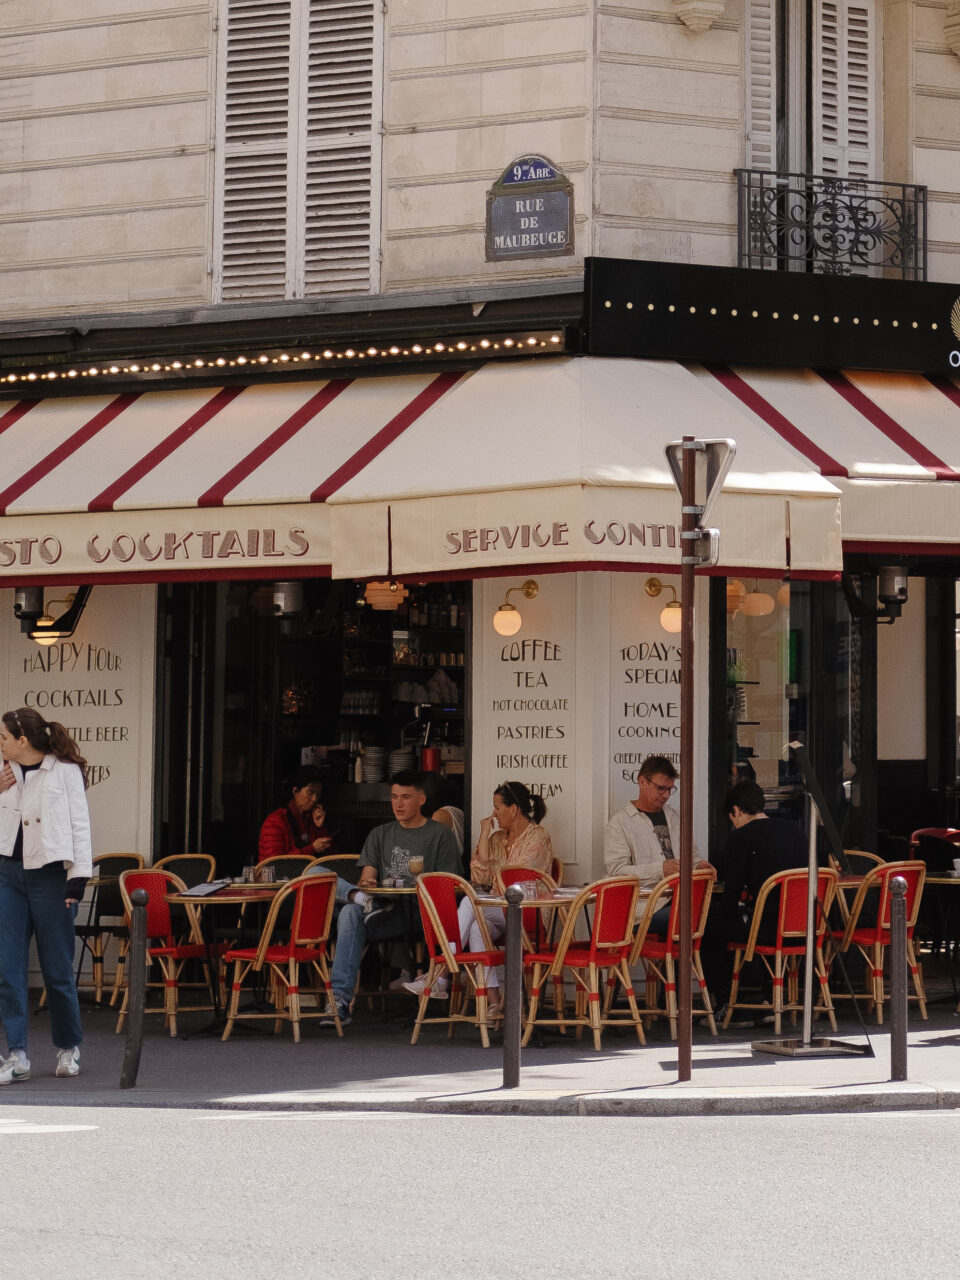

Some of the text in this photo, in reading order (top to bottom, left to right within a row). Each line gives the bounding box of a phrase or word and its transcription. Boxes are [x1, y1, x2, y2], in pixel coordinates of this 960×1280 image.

[515, 198, 545, 213] RUE
[520, 216, 539, 229] DE
[494, 231, 566, 249] MAUBEUGE
[444, 519, 682, 554] SERVICE CONTI
[86, 526, 310, 564] COCKTAILS
[24, 642, 122, 672] HAPPY HOUR
[501, 639, 562, 662] COFFEE
[513, 671, 548, 688] TEA
[24, 688, 123, 707] COCKTAILS
[493, 699, 569, 711] HOT CHOCOLATE
[624, 702, 678, 718] HOME
[96, 726, 129, 742] BEER
[497, 725, 565, 740] PASTRIES
[496, 754, 569, 769] IRISH COFFEE
